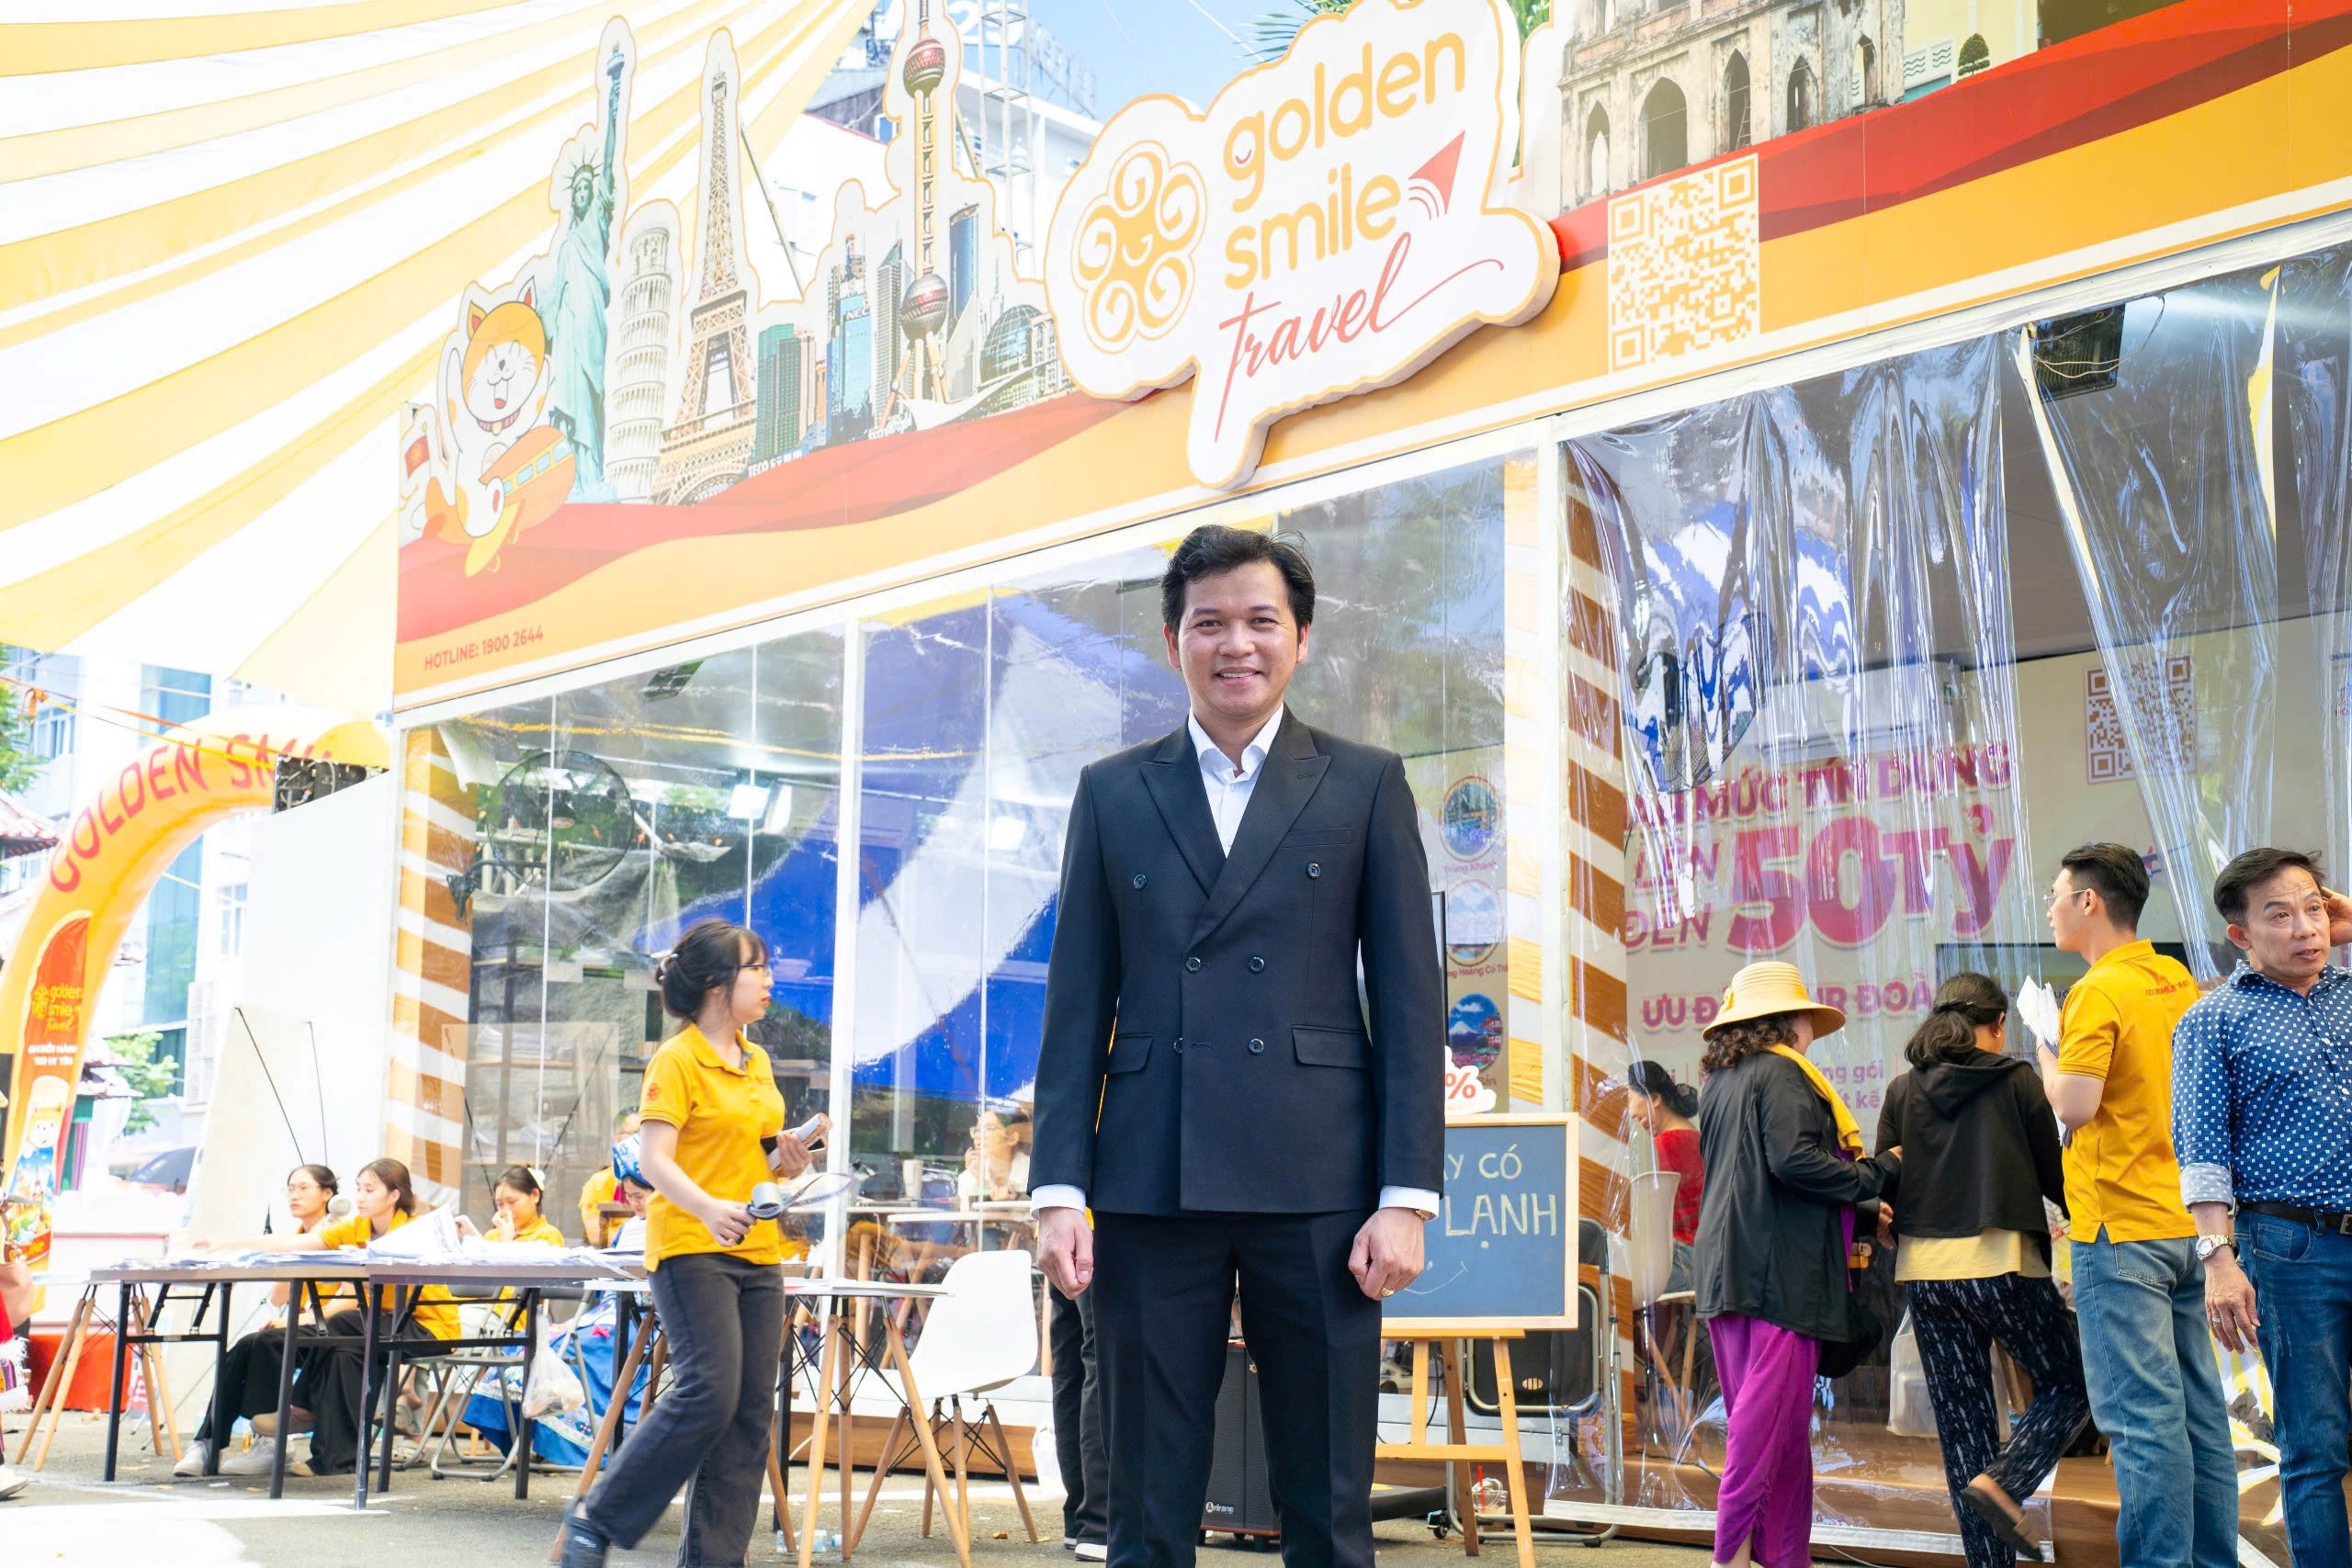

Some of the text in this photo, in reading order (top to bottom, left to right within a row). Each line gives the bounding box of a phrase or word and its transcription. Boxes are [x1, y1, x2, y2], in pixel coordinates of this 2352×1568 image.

[1223, 31, 1465, 212] golden
[1224, 162, 1401, 290] smile
[1215, 231, 1505, 443] travel
[424, 625, 544, 671] HOTLINE: 1900 2644
[50, 737, 210, 893] GOLDEN
[1725, 816, 1897, 953] 50
[1642, 991, 1687, 1028] ƯU
[1854, 971, 1937, 1015] ĐOÀ
[1852, 1059, 1883, 1084] gói
[1477, 1143, 1522, 1180] CÓ
[1444, 1192, 1558, 1249] LẠNH
